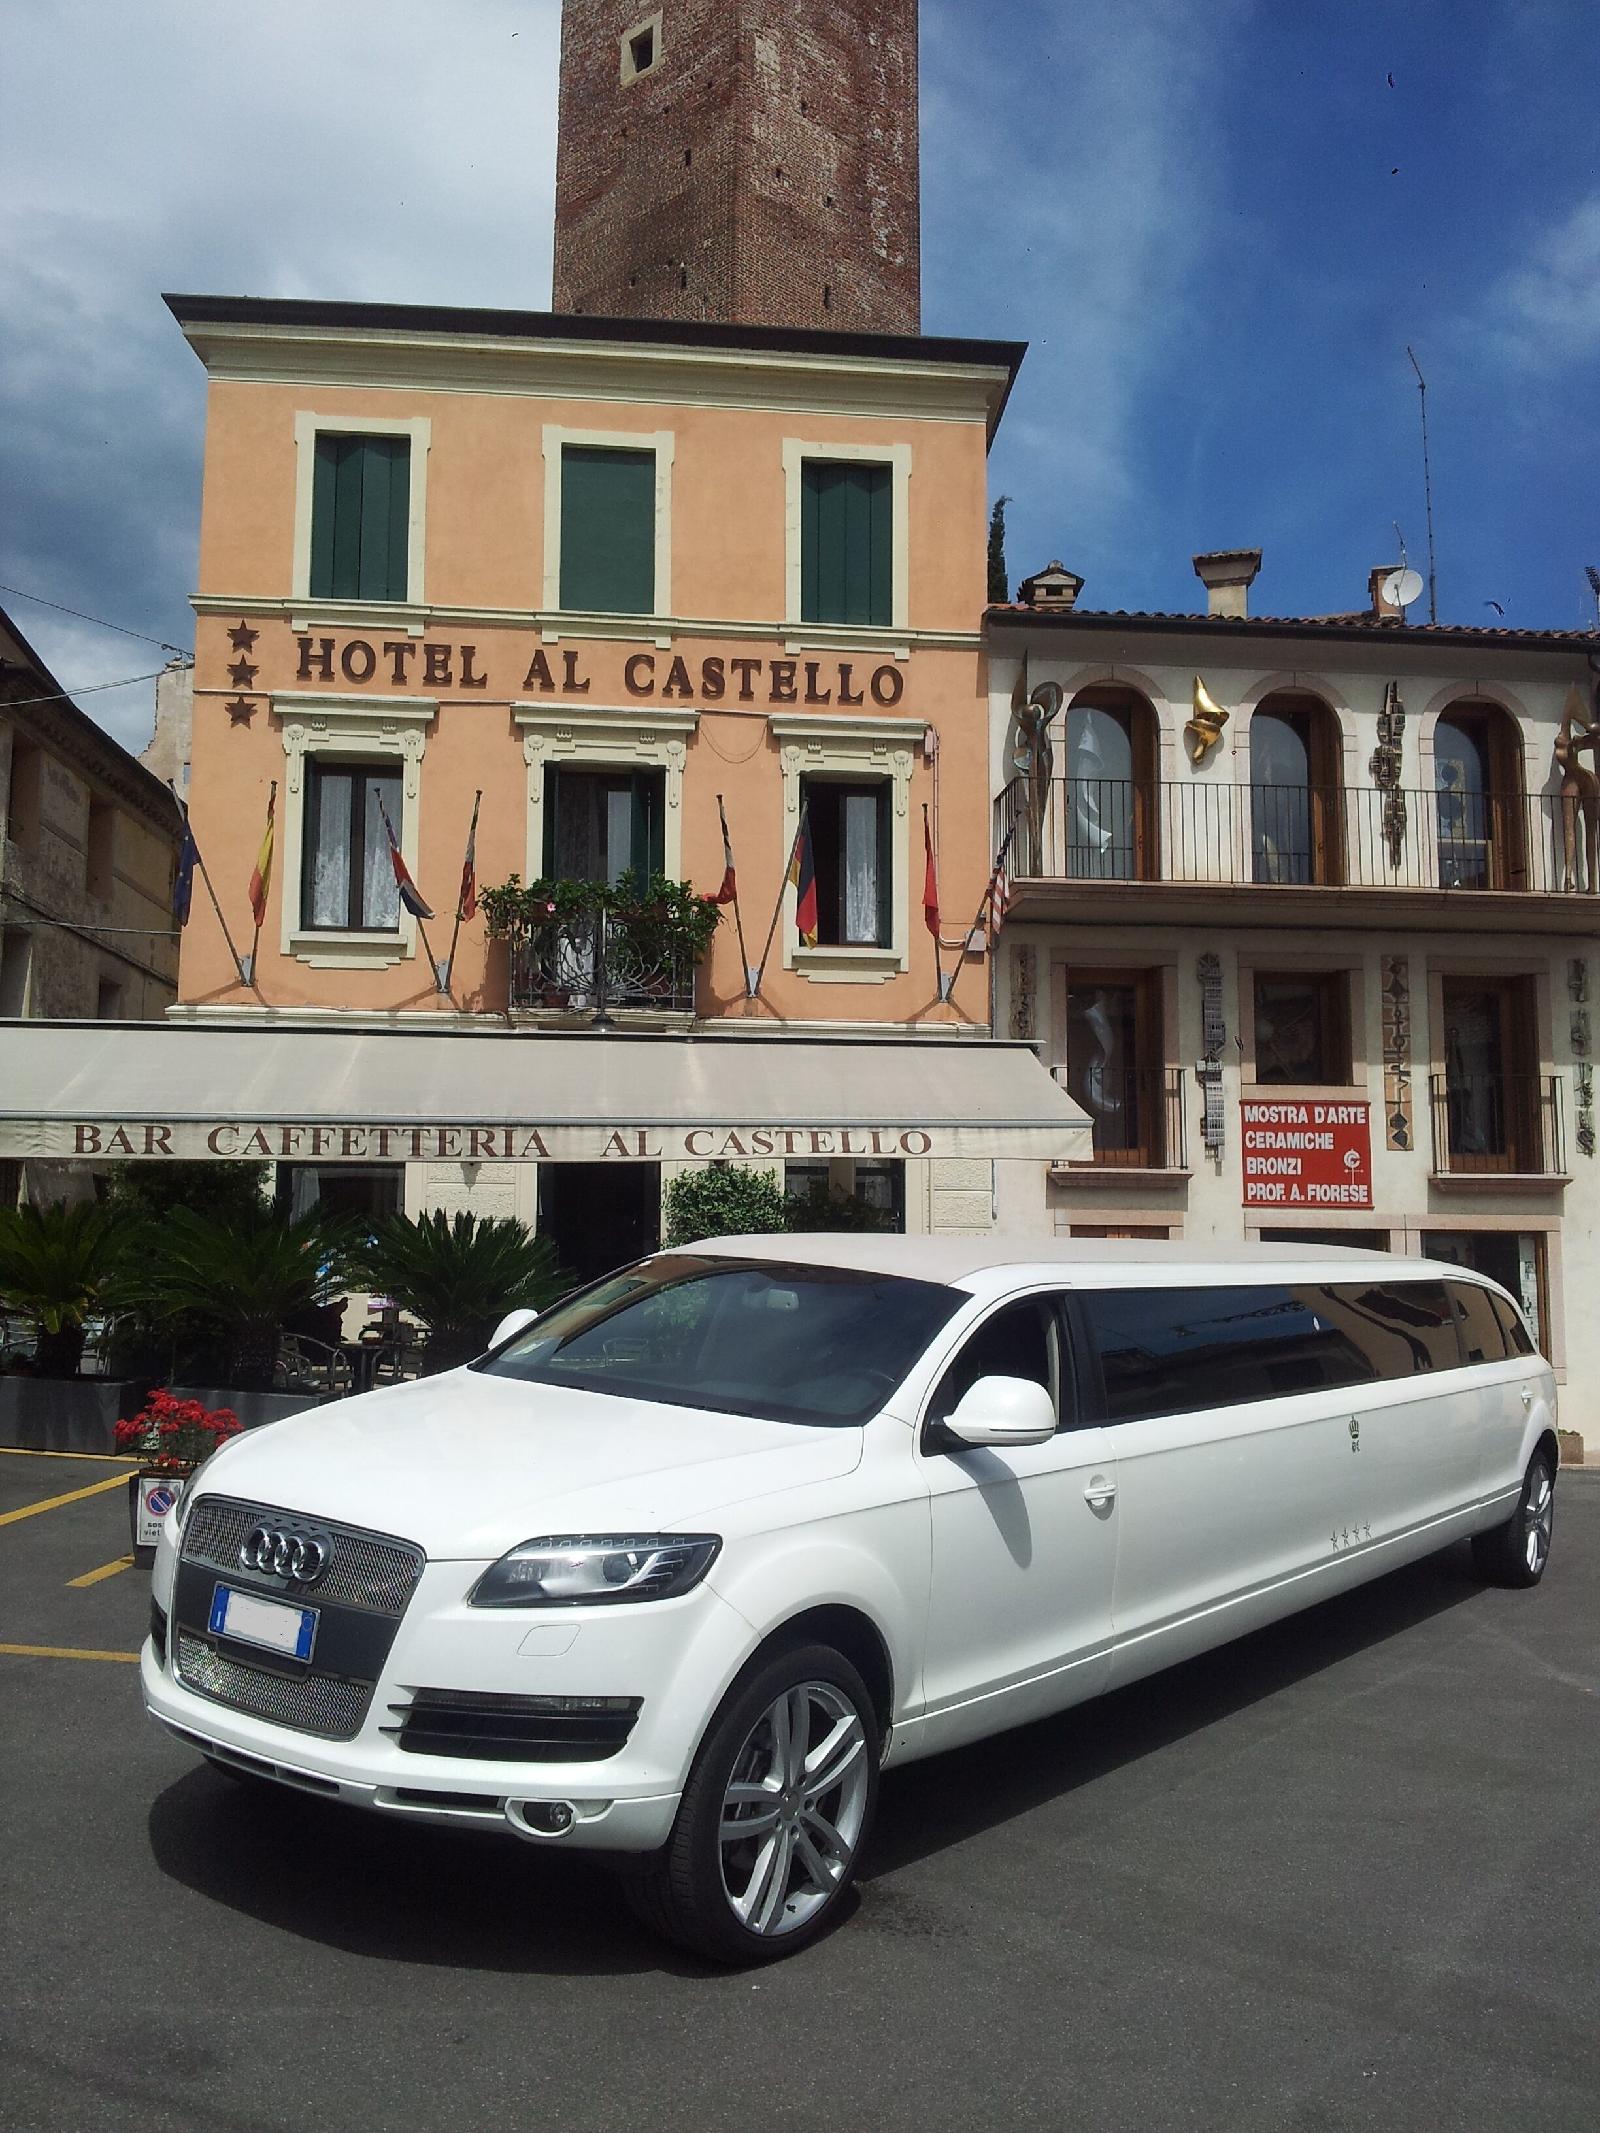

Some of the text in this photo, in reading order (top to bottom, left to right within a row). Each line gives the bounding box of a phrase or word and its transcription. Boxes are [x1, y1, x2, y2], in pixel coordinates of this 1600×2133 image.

[297, 637, 904, 706] HOTEL AL CASTELLO
[1244, 1105, 1366, 1124] MOSTRA D'ARTE
[72, 1124, 932, 1158] BAR CAFFETTERIA AL CASTELLO
[1245, 1130, 1334, 1150] CERAMICHE
[1246, 1156, 1302, 1175] BRONZI
[1247, 1182, 1368, 1203] PROF. A. FIORESE
